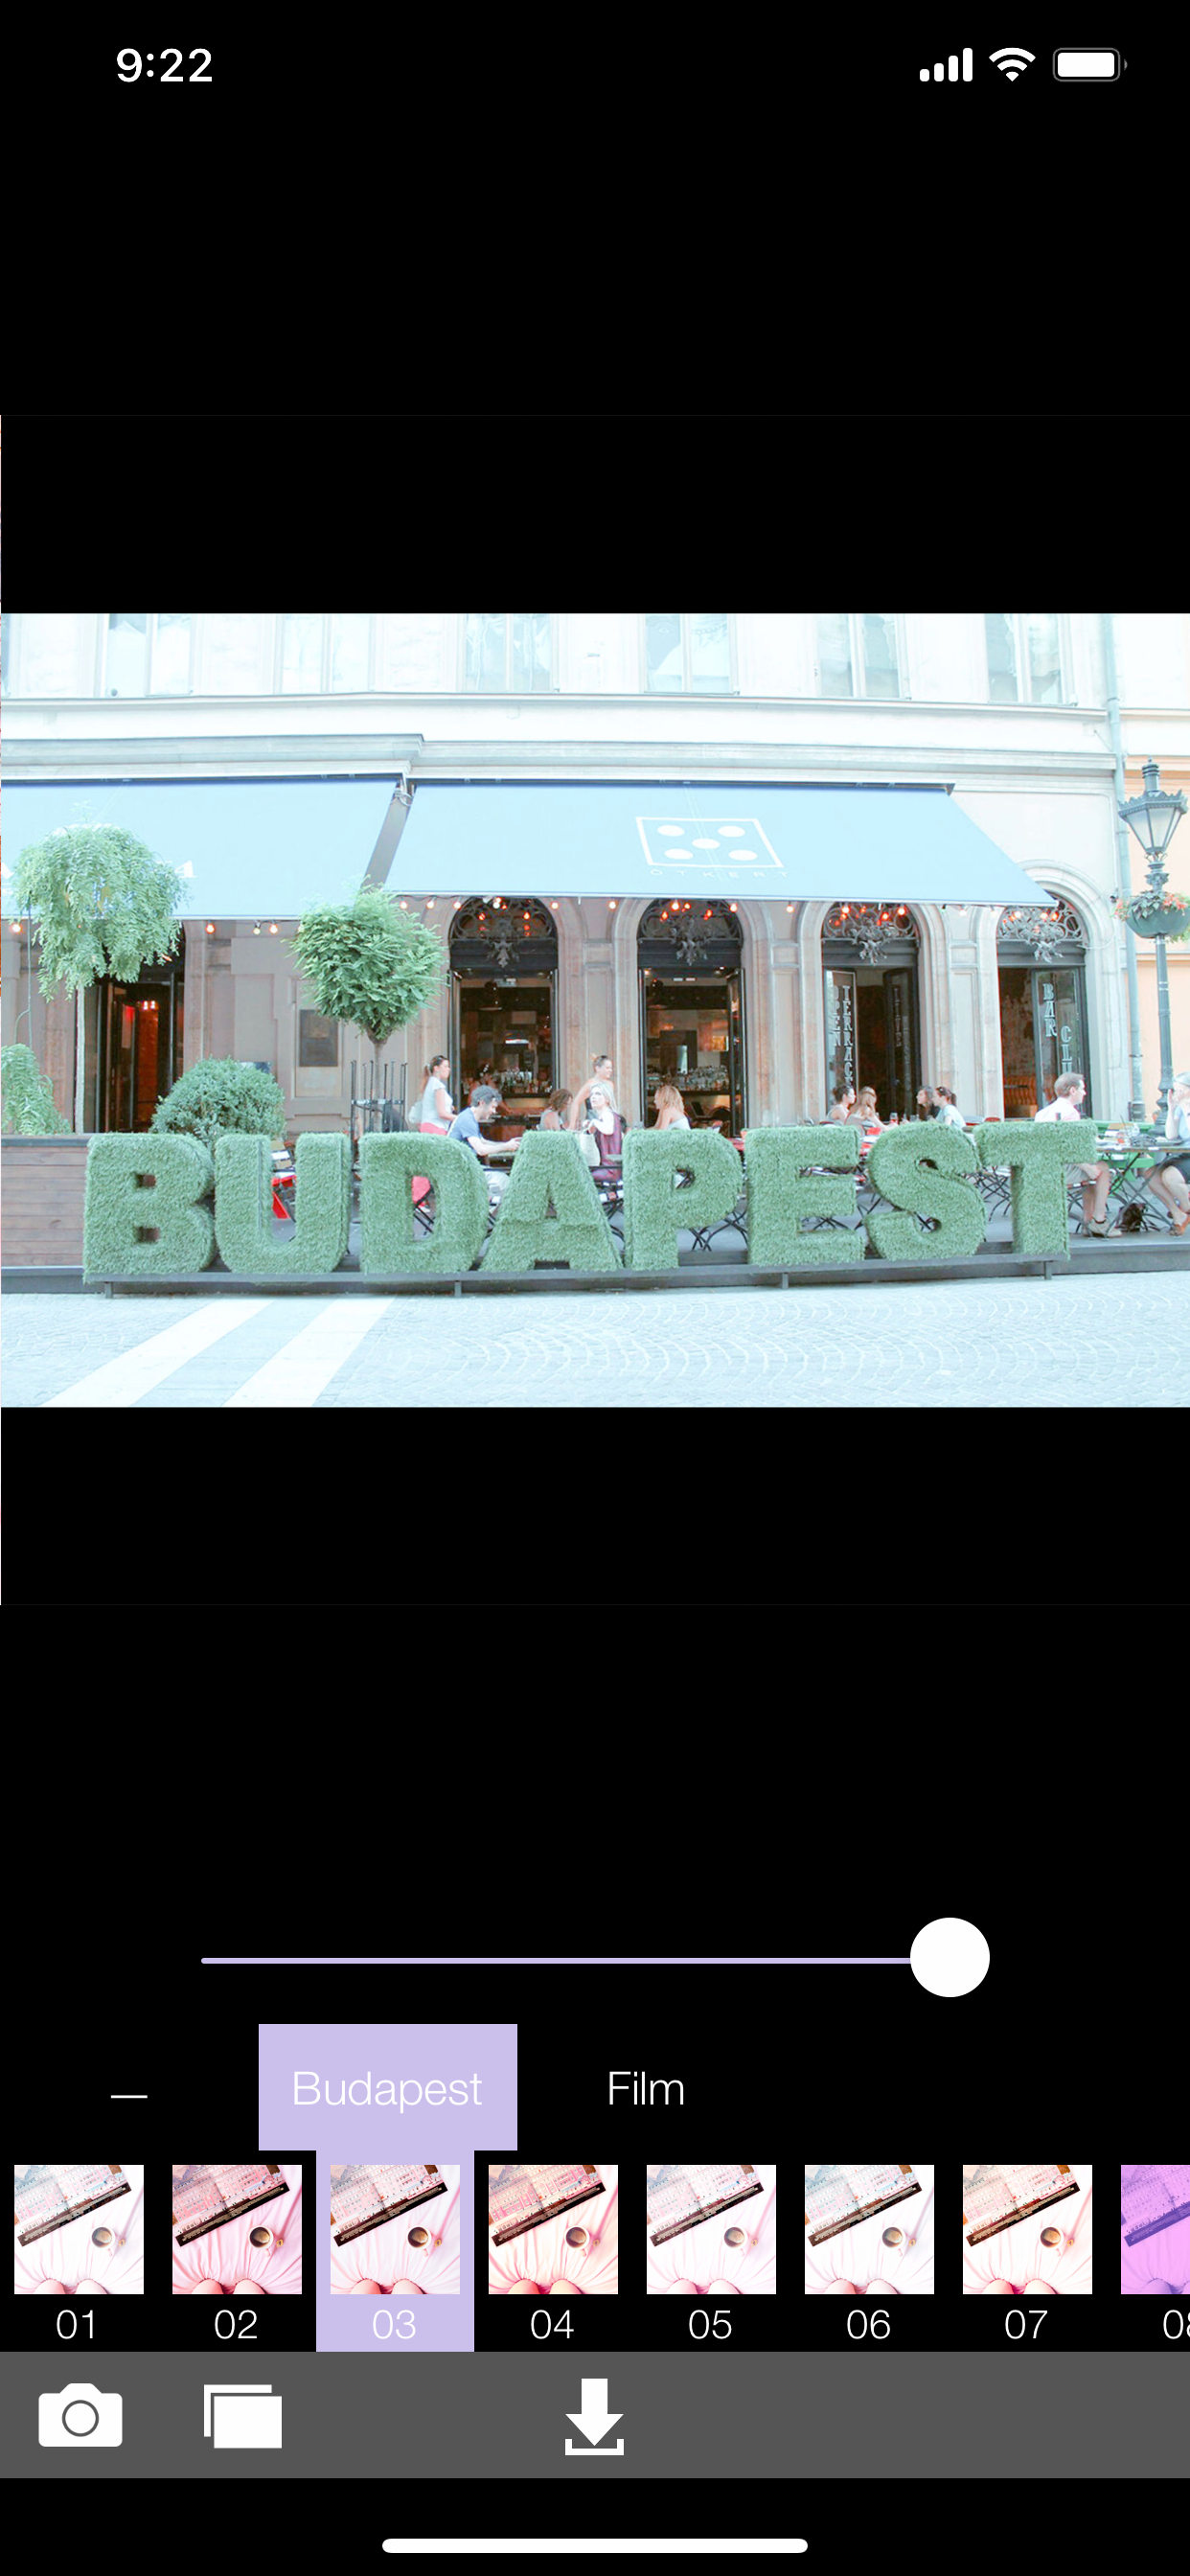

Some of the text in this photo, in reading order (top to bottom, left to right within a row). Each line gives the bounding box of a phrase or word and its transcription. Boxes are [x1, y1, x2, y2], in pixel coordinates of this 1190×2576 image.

[116, 48, 213, 83] 9:22
[1042, 983, 1058, 1037] BAR
[1060, 1025, 1073, 1073] CLU
[82, 1118, 1098, 1282] BUDAPEST
[292, 2071, 483, 2114] Budapest
[608, 2071, 684, 2105] Film
[56, 2309, 94, 2340] 01
[214, 2309, 258, 2340] 02
[372, 2309, 416, 2340] 03
[530, 2309, 575, 2340] 04
[688, 2309, 732, 2340] 05
[846, 2309, 891, 2340] 06
[1004, 2309, 1048, 2340] 07
[1162, 2309, 1190, 2340] 0
